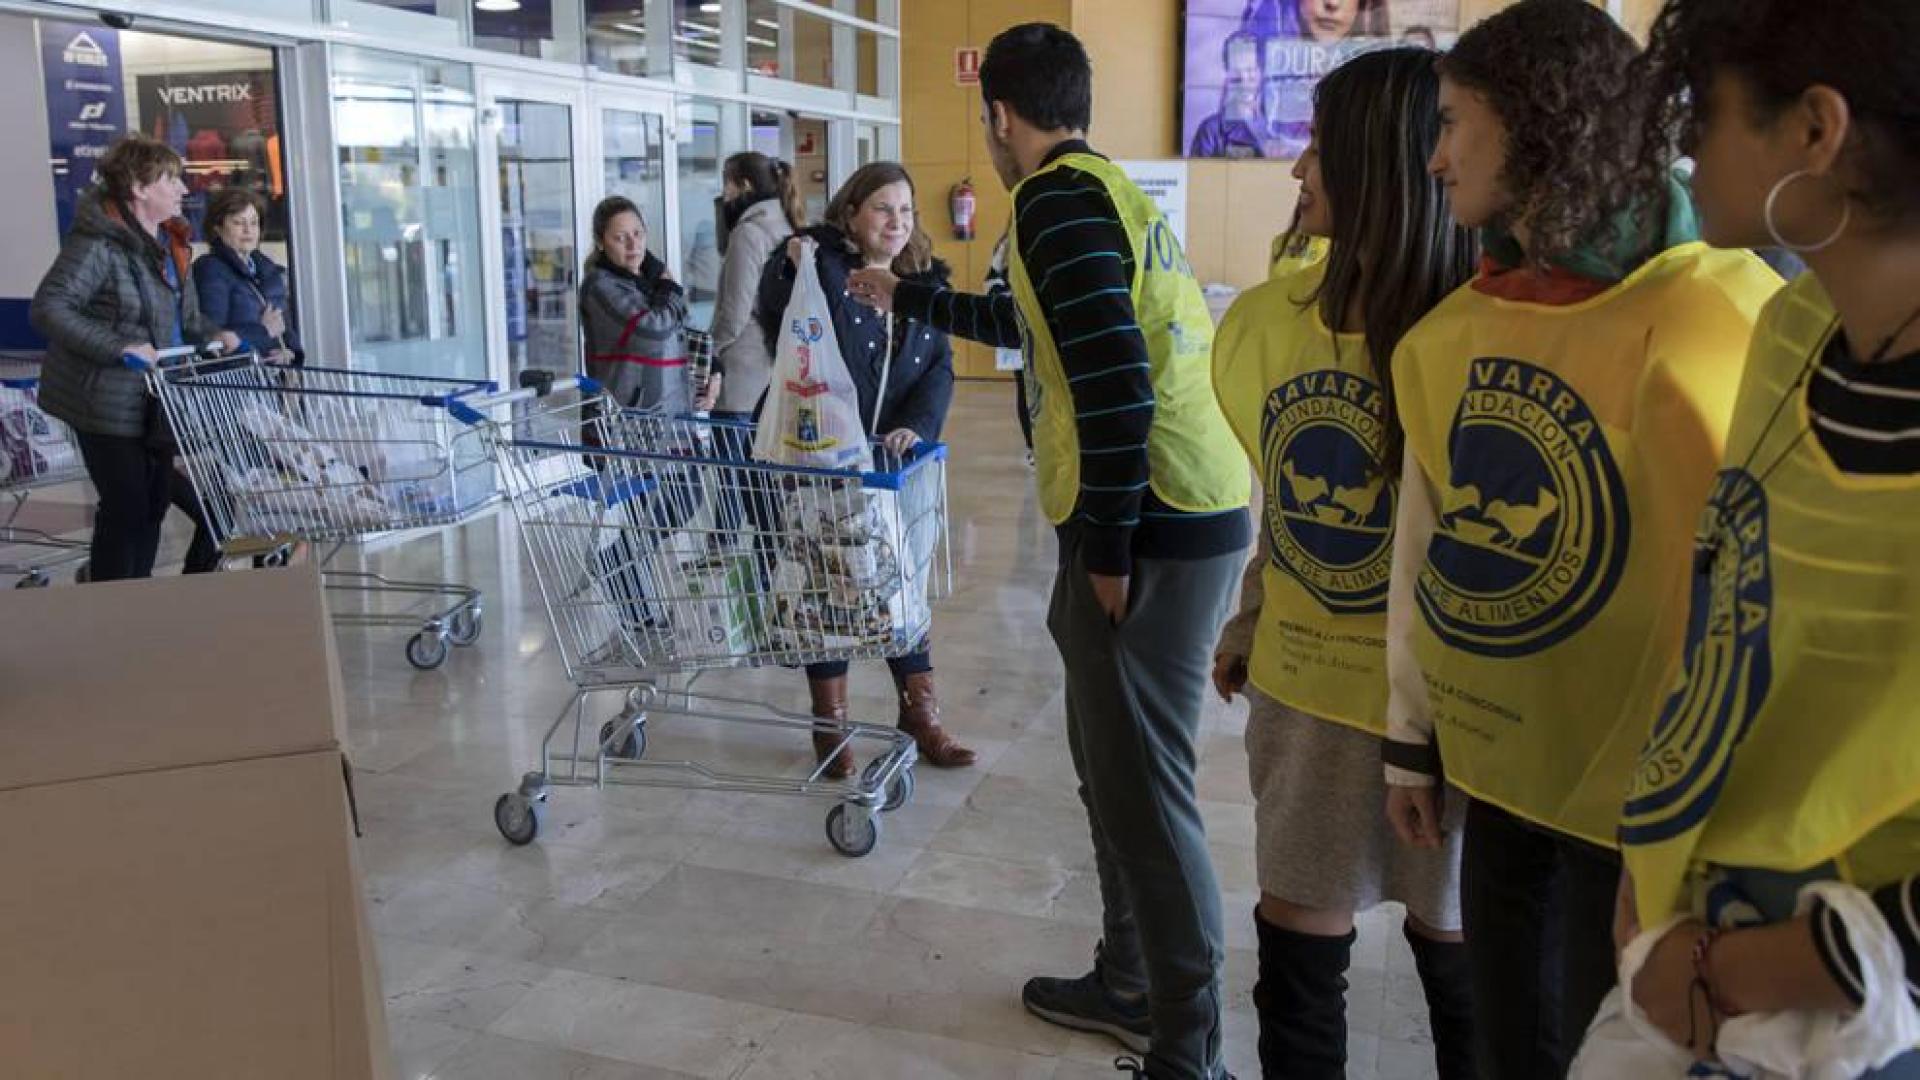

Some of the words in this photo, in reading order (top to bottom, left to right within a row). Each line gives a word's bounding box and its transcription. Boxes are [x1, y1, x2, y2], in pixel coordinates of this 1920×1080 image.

[1270, 45, 1352, 75] DURA
[158, 83, 250, 104] VENTRIX
[1267, 372, 1383, 417] NAVARR
[1474, 361, 1594, 446] VARRA
[1466, 392, 1576, 460] NDACION
[1328, 546, 1393, 590] ALIMEN
[1458, 550, 1581, 622] ALIMENTOS
